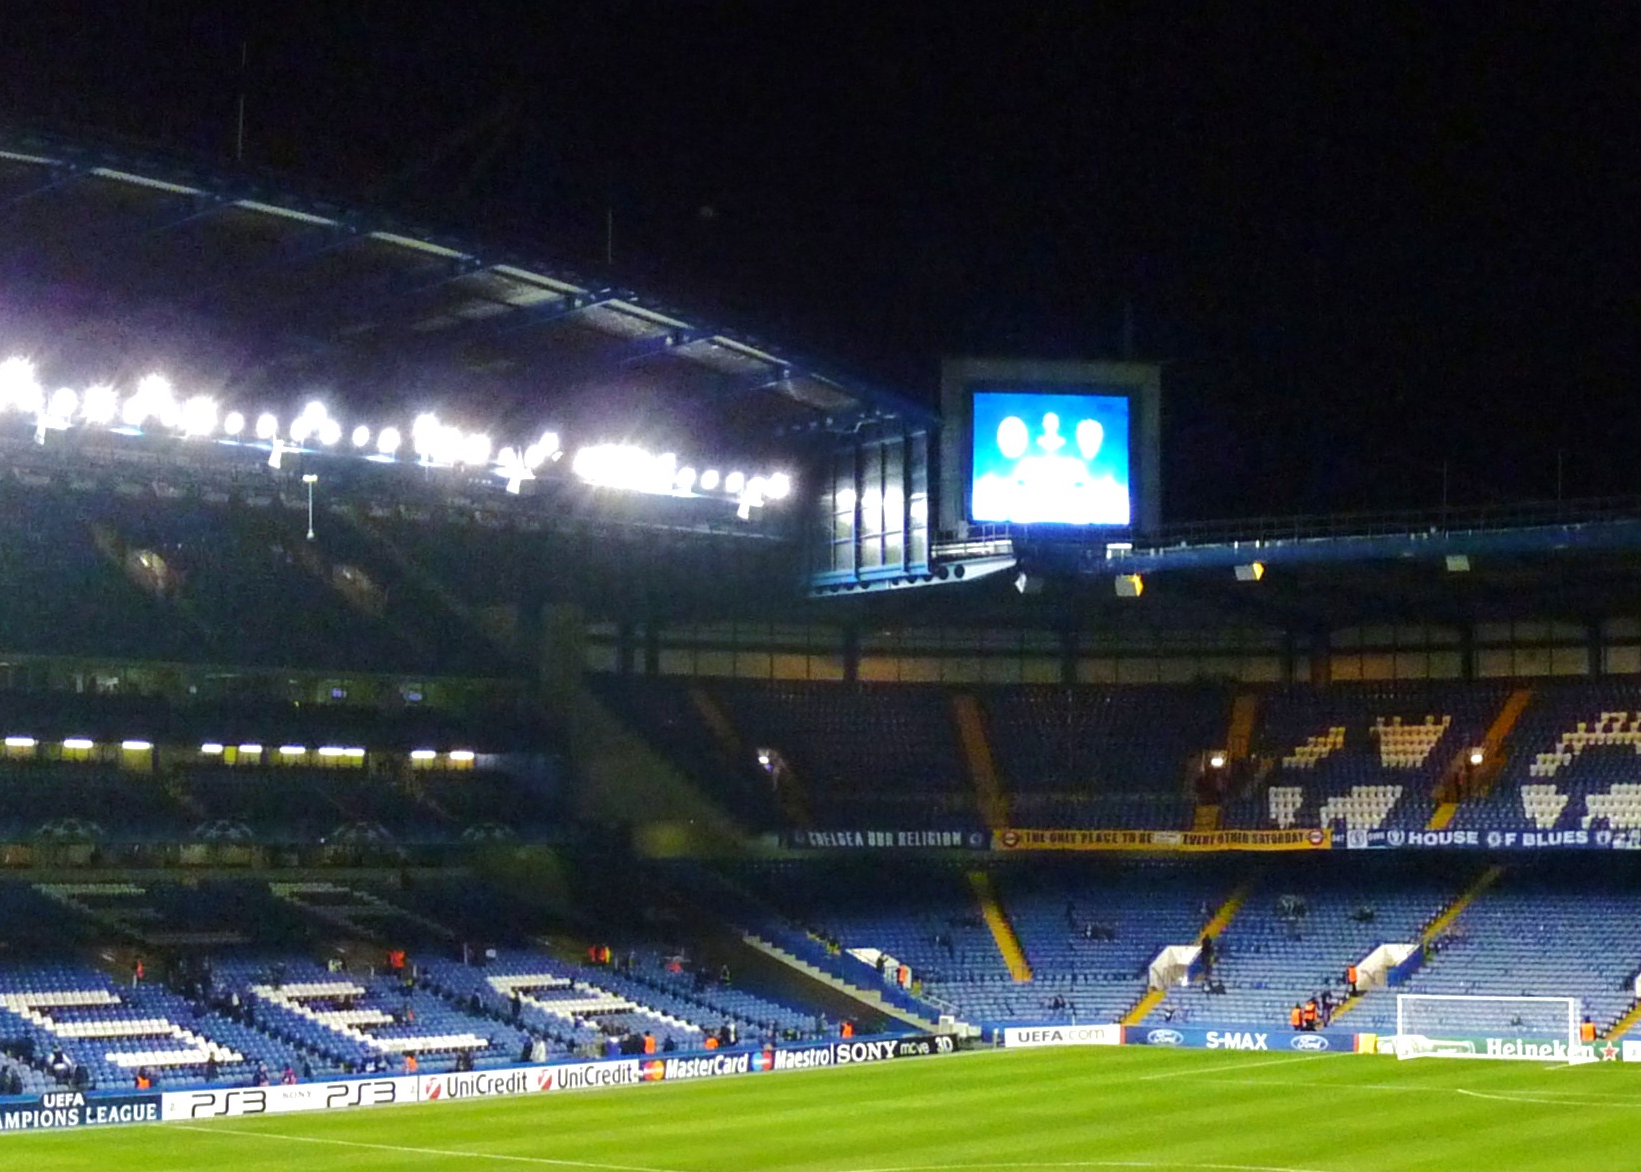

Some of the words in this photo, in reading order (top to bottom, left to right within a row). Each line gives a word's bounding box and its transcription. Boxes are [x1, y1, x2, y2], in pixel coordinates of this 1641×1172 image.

[1409, 831, 1479, 846] HOUSE
[1522, 830, 1589, 847] BLUES
[836, 1039, 898, 1063] SONY
[935, 1036, 954, 1052] 3D
[1205, 1031, 1269, 1051] S-MAX
[665, 1053, 749, 1080] MasterCard
[774, 1046, 830, 1070] Maestro
[447, 1069, 529, 1097] UniCredit
[557, 1063, 633, 1090] UniCredit
[43, 1093, 85, 1107] UEFA
[191, 1090, 267, 1118] PS3
[326, 1080, 396, 1108] PS3
[85, 1102, 157, 1123] LEAGUE
